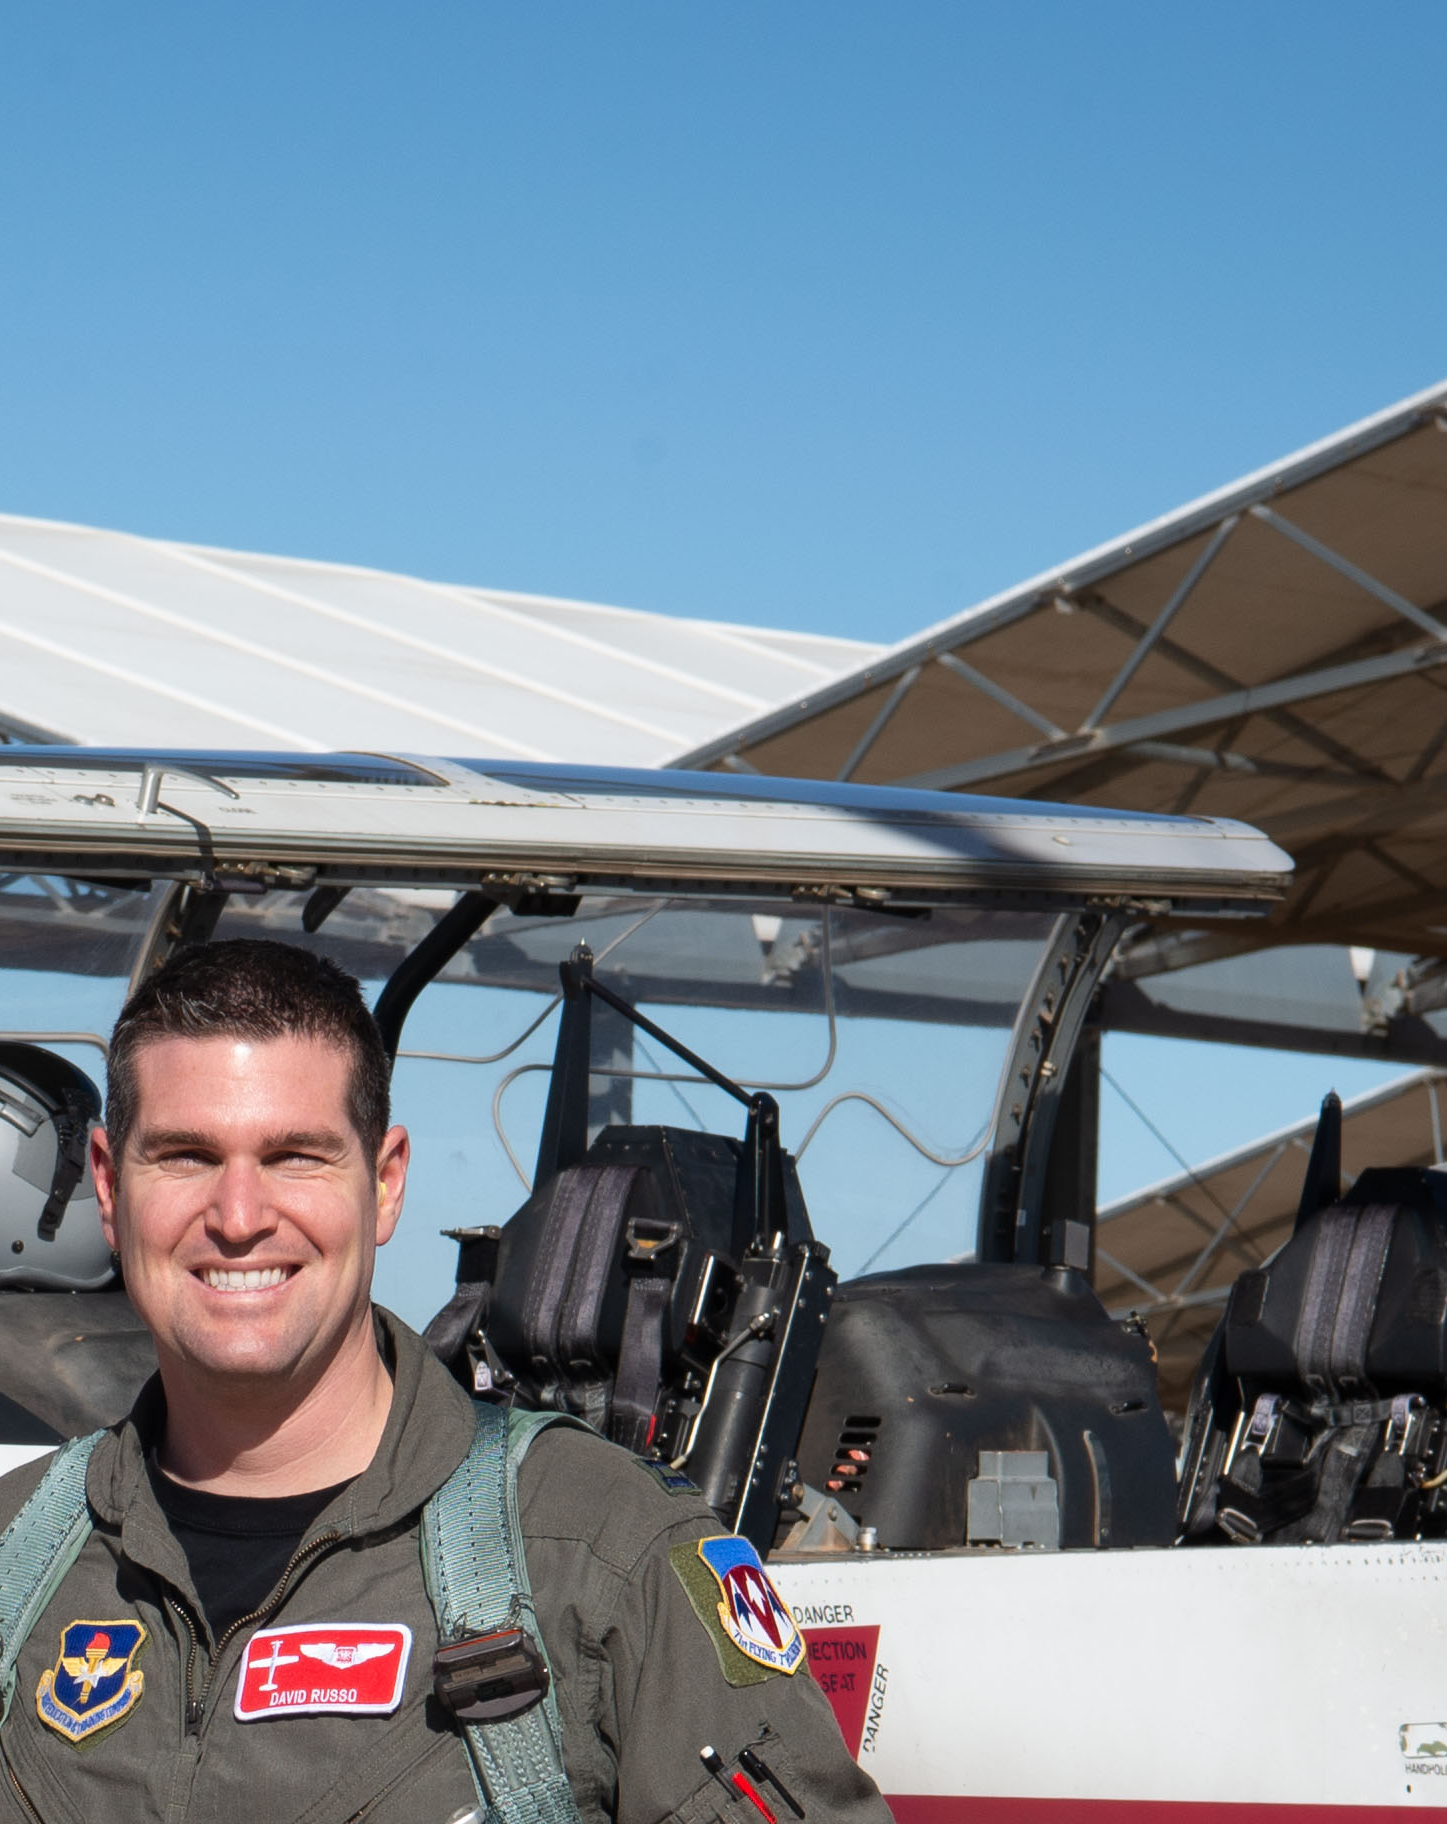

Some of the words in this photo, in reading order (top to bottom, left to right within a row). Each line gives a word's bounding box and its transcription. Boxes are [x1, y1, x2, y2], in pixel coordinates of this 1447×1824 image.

[793, 1605, 854, 1624] DANGER
[749, 1641, 777, 1664] FLYING
[269, 1689, 307, 1707] DAVID
[310, 1688, 357, 1704] RUSSO
[862, 1663, 890, 1754] DANGER
